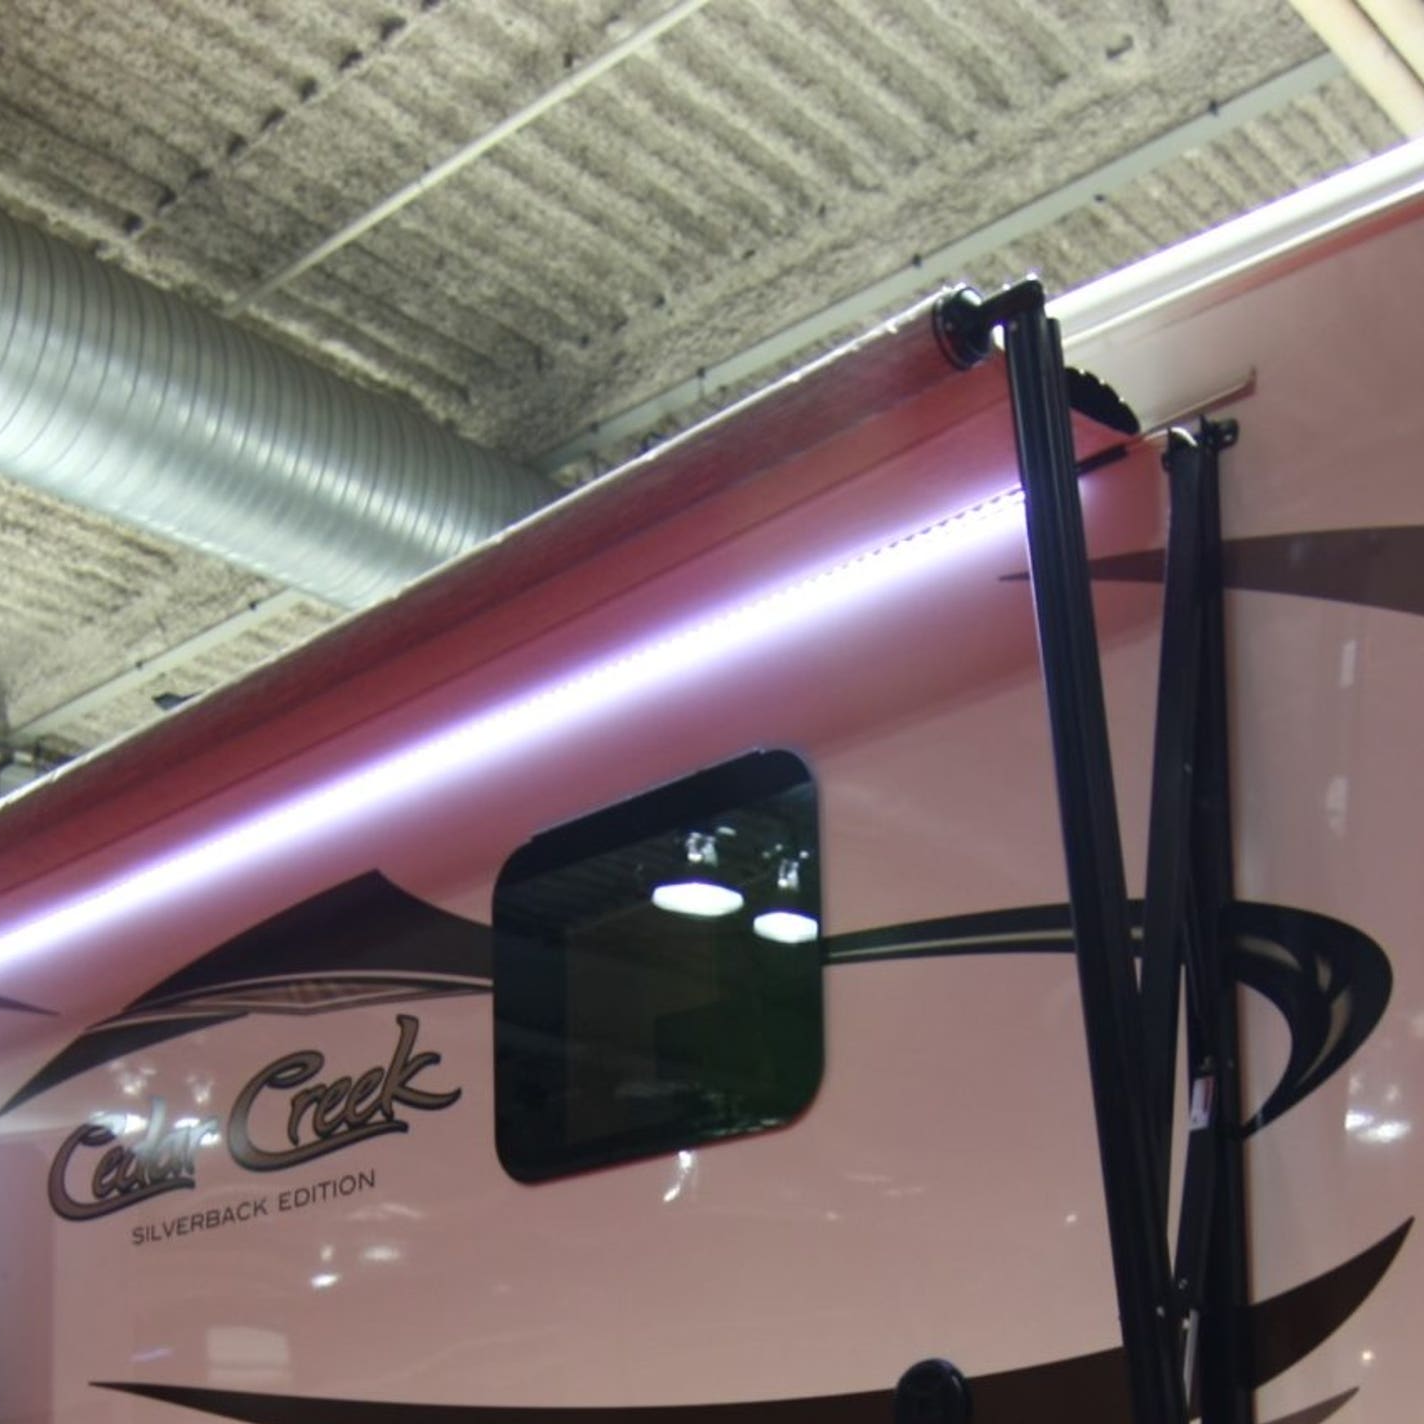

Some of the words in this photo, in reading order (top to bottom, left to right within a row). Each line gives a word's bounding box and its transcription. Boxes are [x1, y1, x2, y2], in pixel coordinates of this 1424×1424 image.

[47, 1097, 222, 1222] Cedar
[227, 1013, 463, 1172] Creek
[131, 1200, 268, 1246] SILVERBACK
[278, 1169, 377, 1212] EDITION
